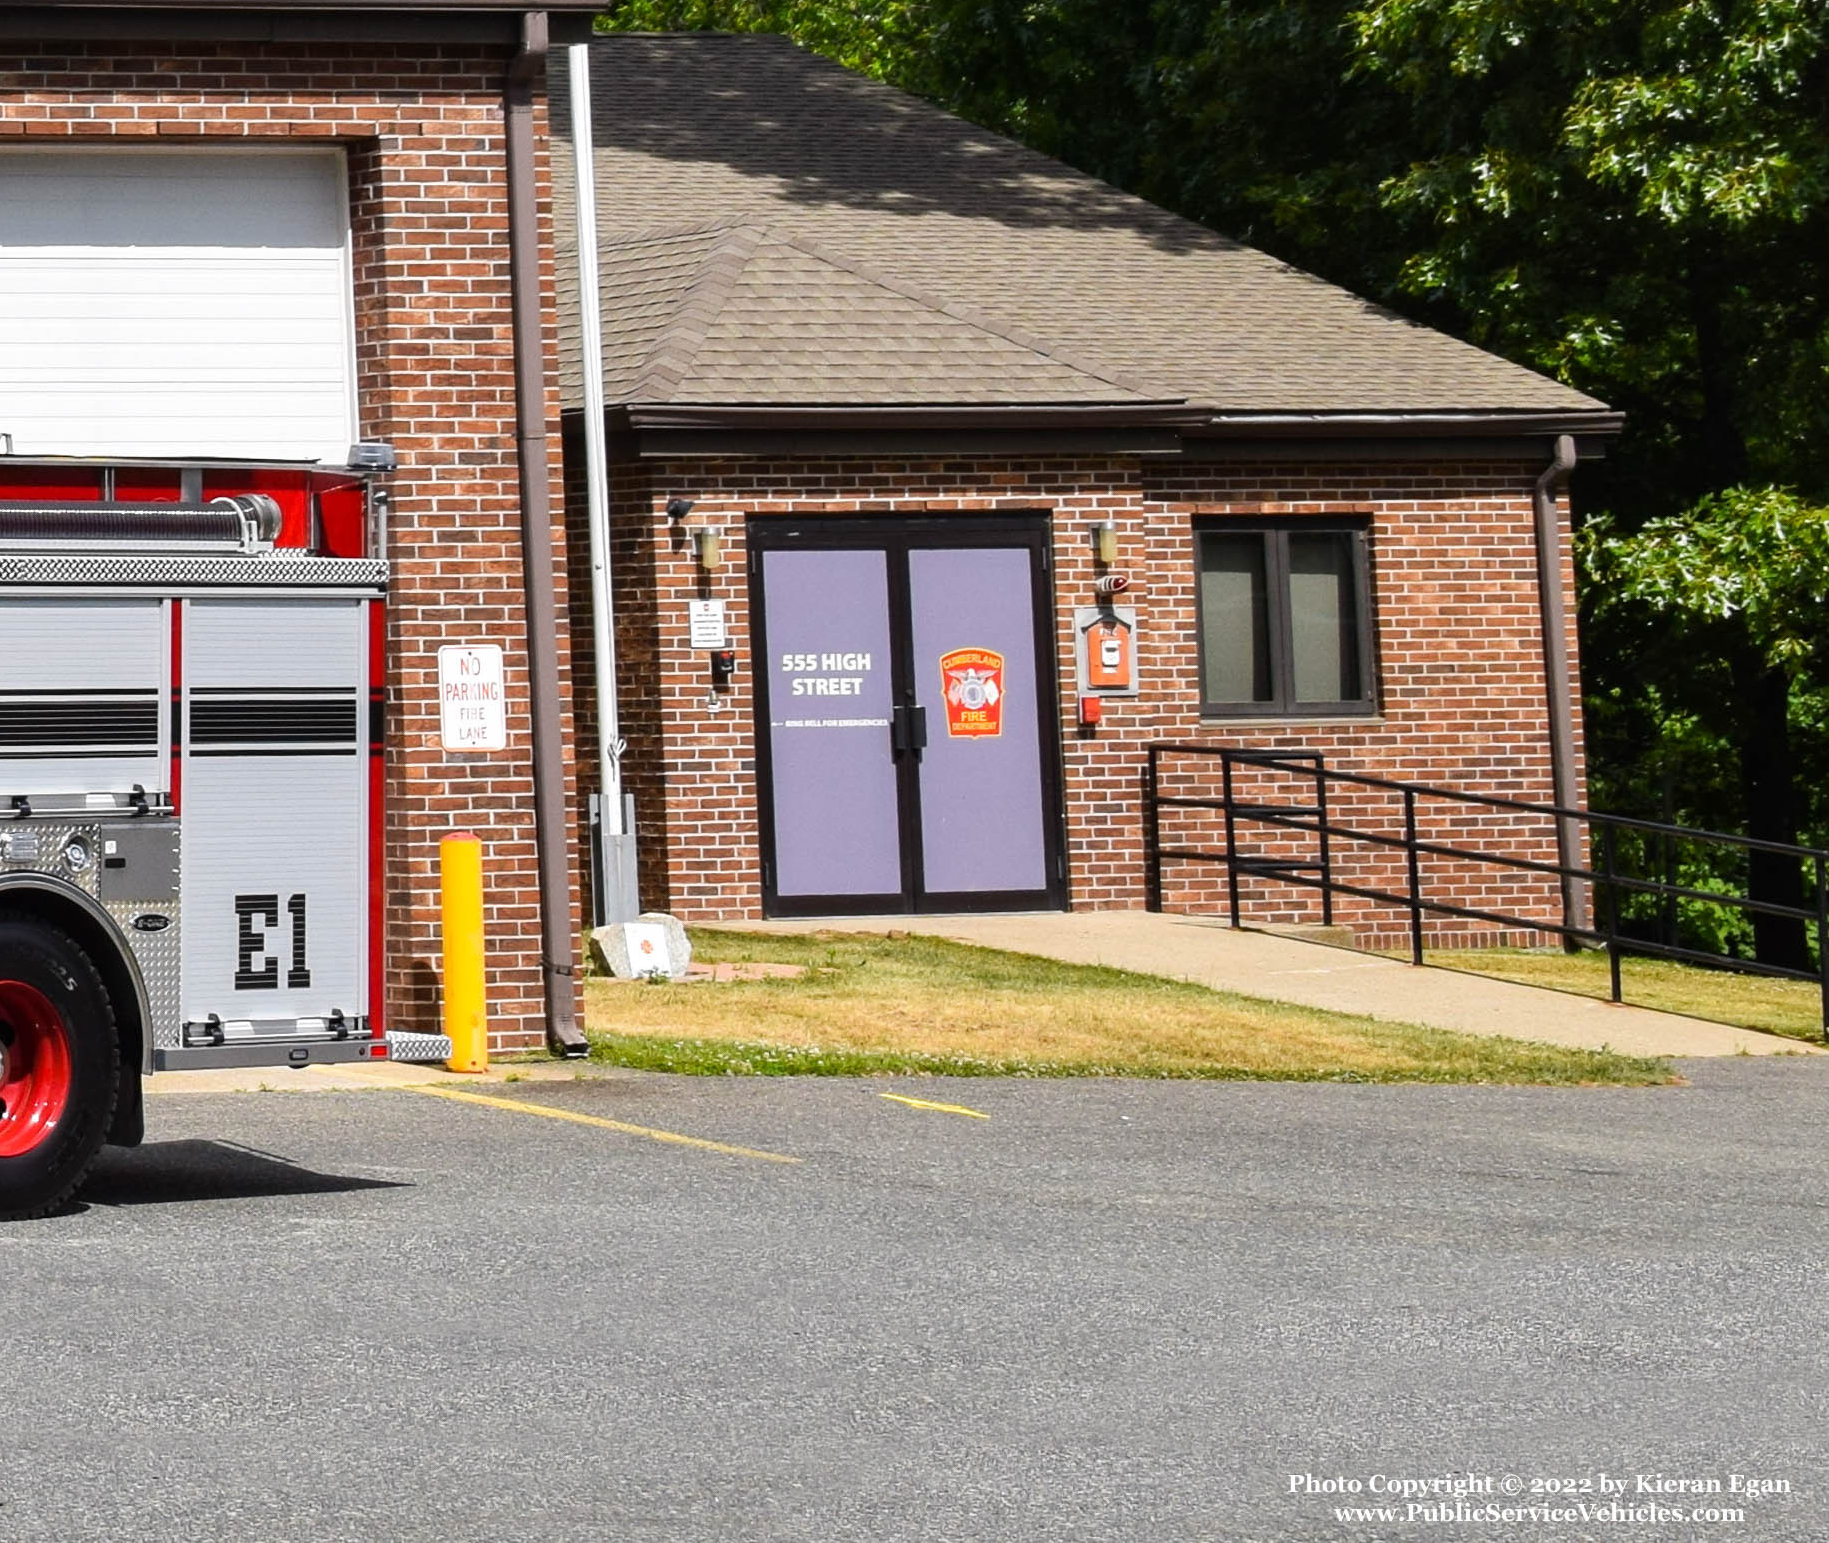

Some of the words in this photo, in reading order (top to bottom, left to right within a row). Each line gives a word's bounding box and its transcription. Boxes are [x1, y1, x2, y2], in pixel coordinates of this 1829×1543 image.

[460, 657, 481, 676] NO
[782, 654, 818, 672] 555
[821, 653, 872, 671] HIGH
[943, 654, 1001, 669] CUMBERLAND
[445, 682, 499, 701] PARKING
[792, 678, 863, 695] STREET
[460, 707, 485, 720] FIRE
[961, 711, 988, 722] FIRE
[459, 726, 488, 740] LANE
[234, 893, 311, 990] E1
